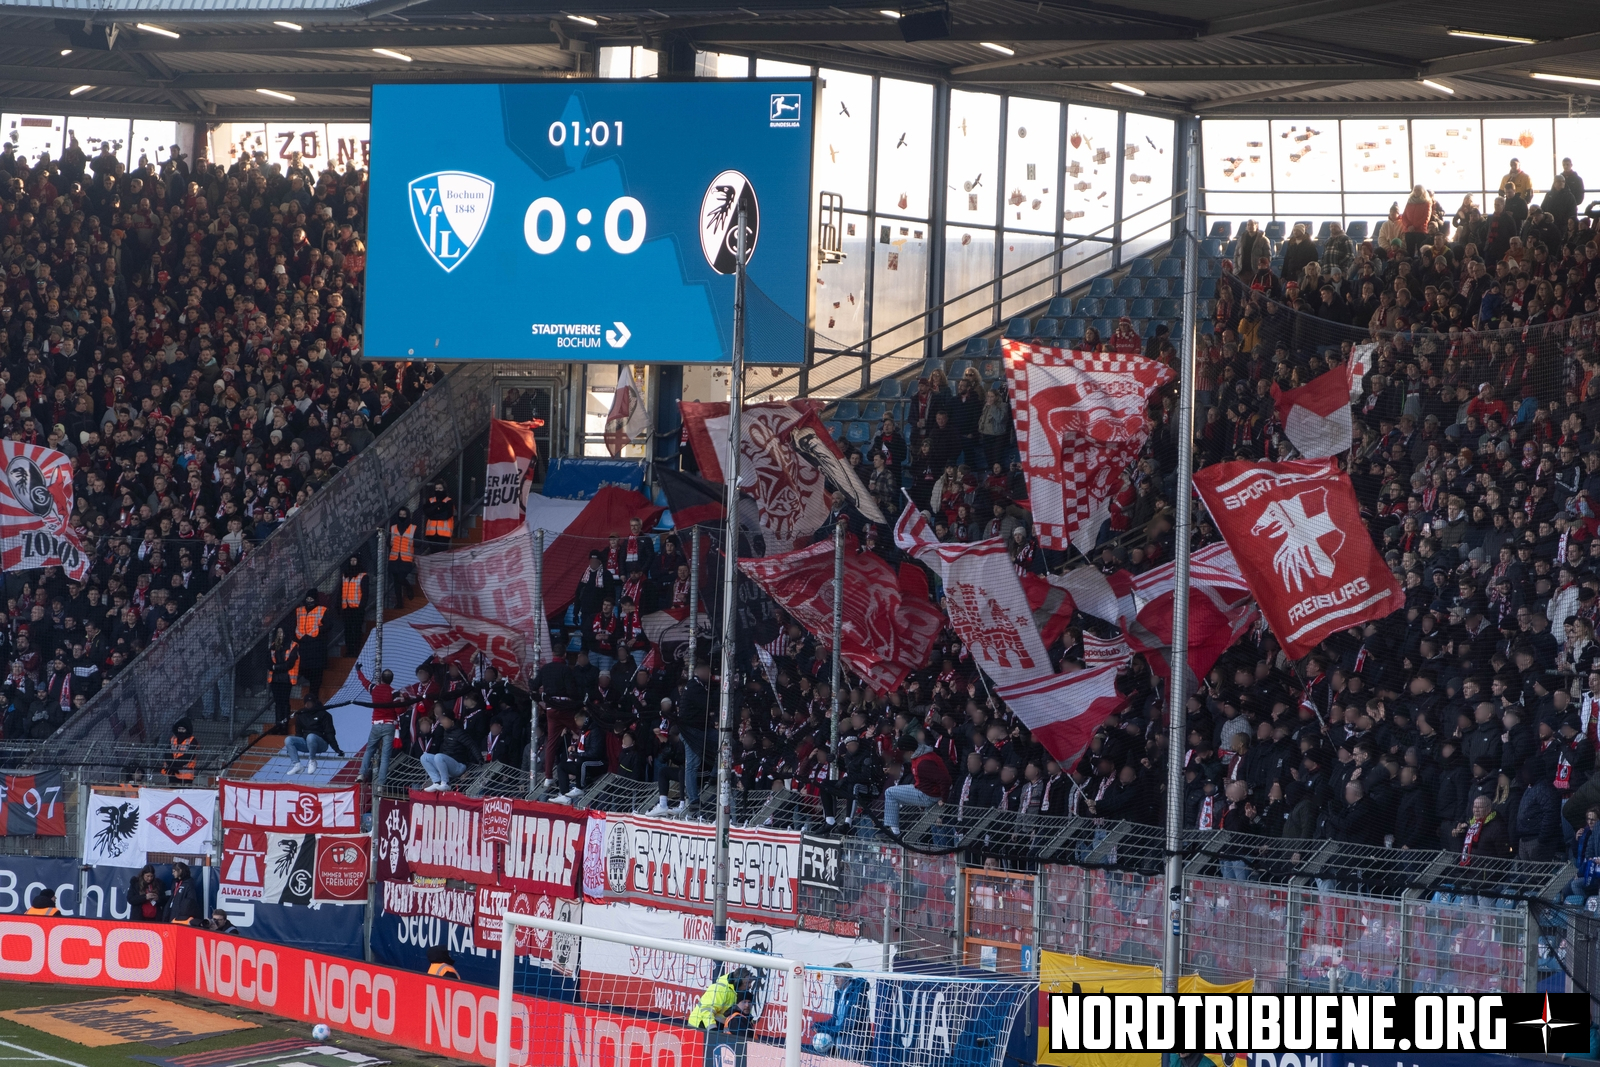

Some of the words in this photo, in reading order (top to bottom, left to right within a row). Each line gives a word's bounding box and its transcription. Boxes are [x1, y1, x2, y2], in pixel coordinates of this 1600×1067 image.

[548, 121, 624, 147] 01:01
[446, 189, 485, 200] Bochum
[454, 203, 476, 214] 1848
[523, 195, 647, 256] 0:0
[531, 323, 601, 336] STADTWERKE
[556, 336, 601, 349] BOCHUM
[23, 786, 62, 820] 97
[221, 887, 251, 897] ALWAYS
[325, 878, 359, 887] FREIBURG
[0, 869, 131, 920] Bochu
[195, 936, 279, 1007] NOCO
[303, 958, 396, 1036] NOCO
